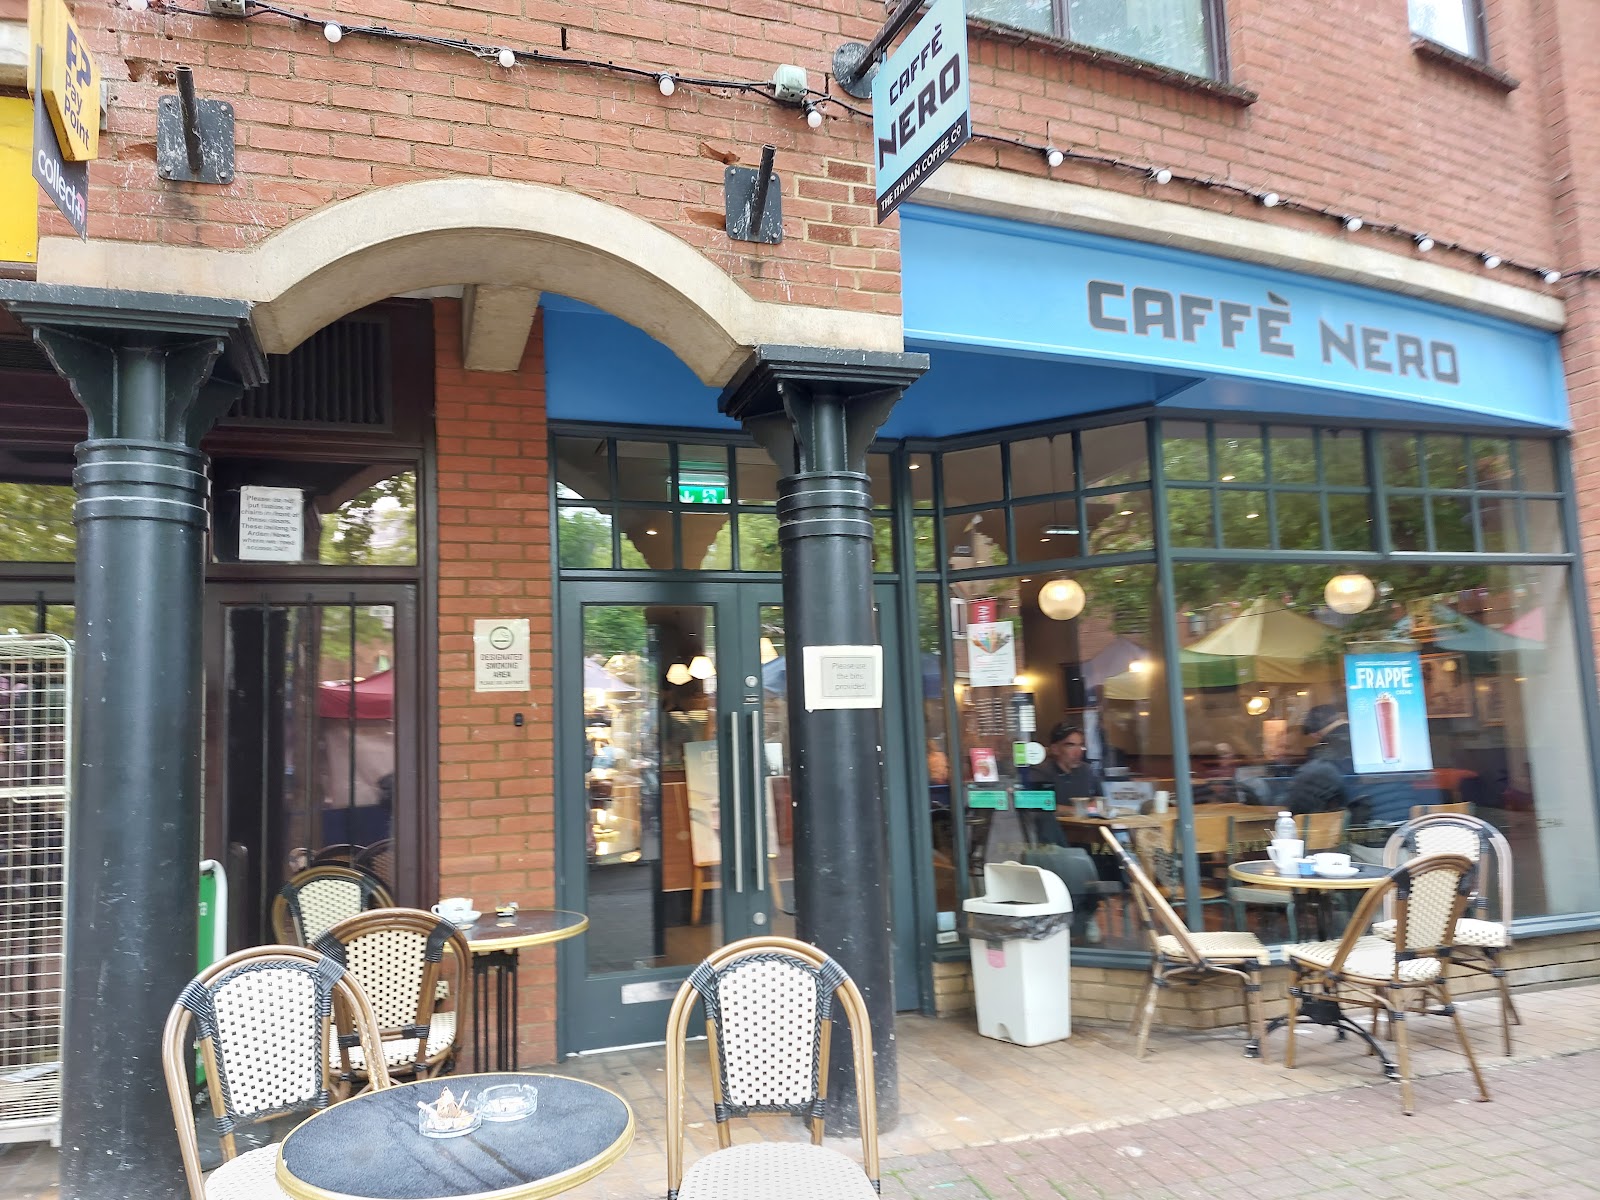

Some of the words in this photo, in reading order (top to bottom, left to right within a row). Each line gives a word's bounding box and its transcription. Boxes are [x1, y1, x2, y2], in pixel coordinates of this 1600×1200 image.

[65, 69, 82, 116] Pay
[889, 23, 943, 106] CAFFÈ
[64, 94, 90, 151] Point
[878, 52, 961, 171] NERO
[880, 192, 894, 212] THE
[894, 163, 921, 200] ITALIAN
[921, 137, 950, 173] COFFEE
[1086, 279, 1295, 359] CAFFÈ
[1318, 318, 1460, 385] NERO
[480, 653, 523, 661] DESIGNATED
